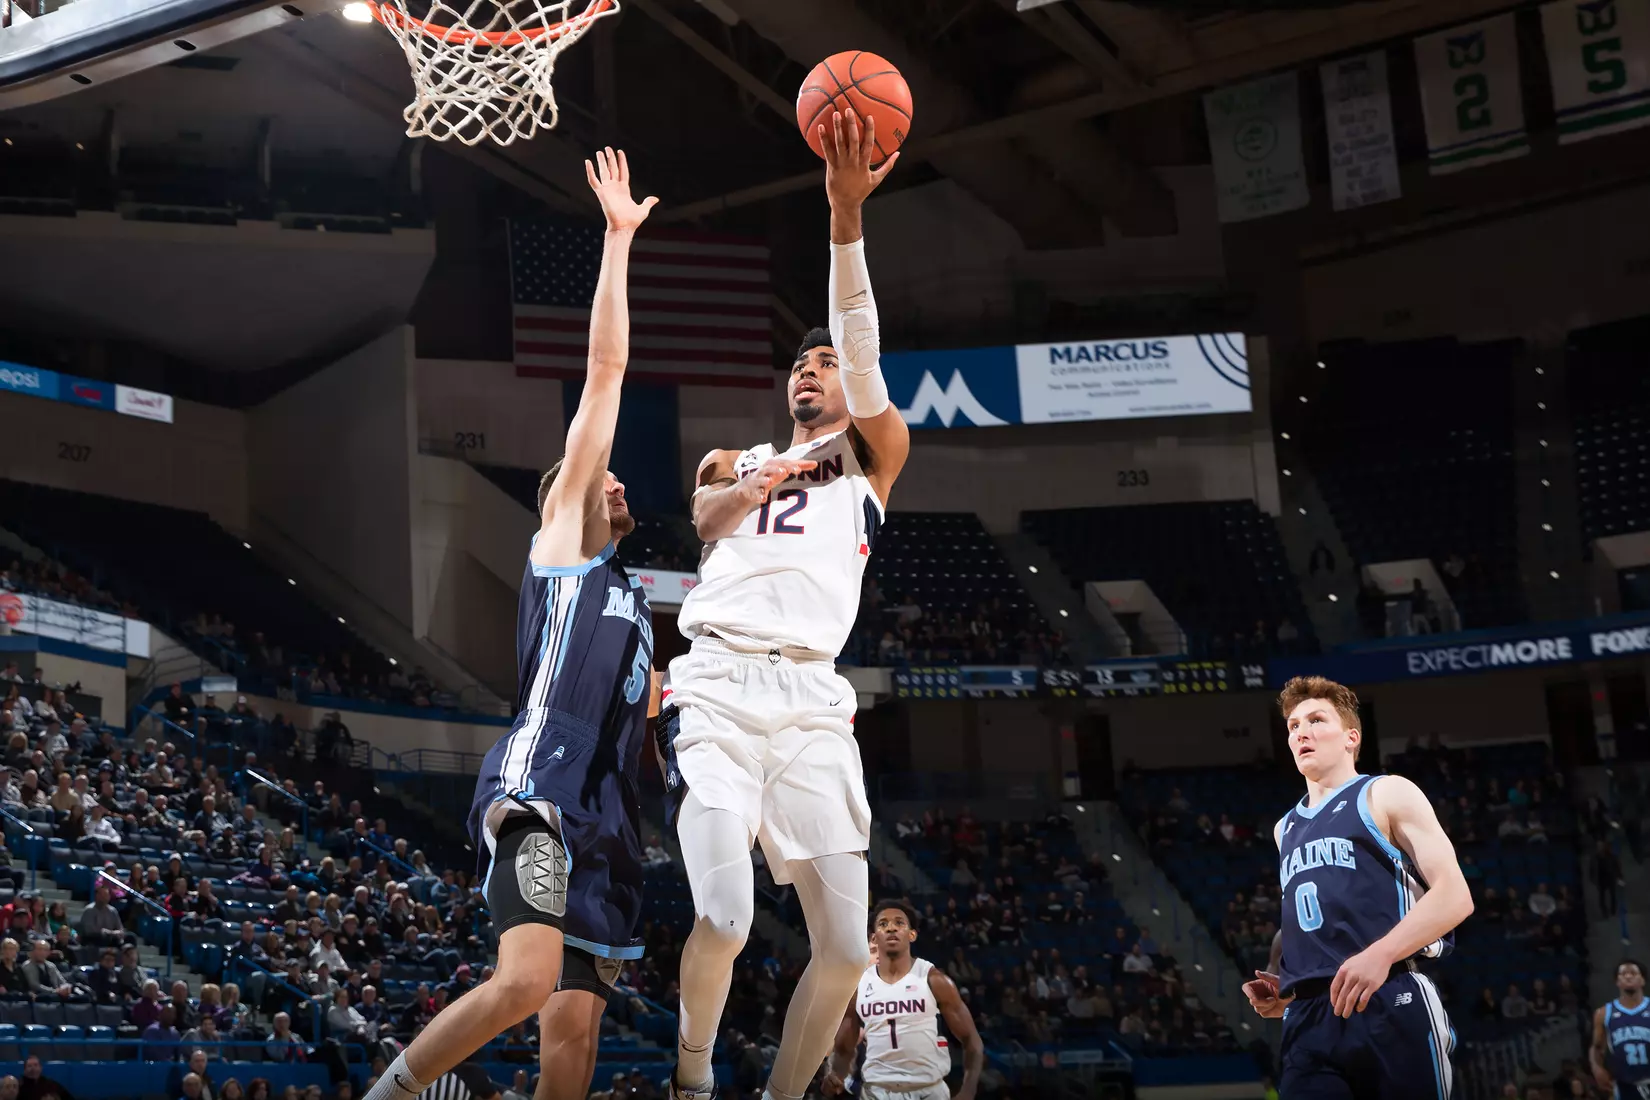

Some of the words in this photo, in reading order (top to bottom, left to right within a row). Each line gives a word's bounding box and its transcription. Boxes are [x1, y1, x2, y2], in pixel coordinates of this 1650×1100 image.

[1581, 37, 1626, 94] 5
[1453, 72, 1492, 131] 2
[1049, 341, 1169, 365] MARCUS
[58, 442, 92, 462] 207
[455, 432, 486, 449] 231
[1117, 470, 1149, 487] 233
[756, 488, 809, 535] 12
[624, 643, 650, 705] 5
[1295, 881, 1324, 932] 0
[860, 999, 926, 1018] UCONN
[887, 1018, 898, 1050] 1
